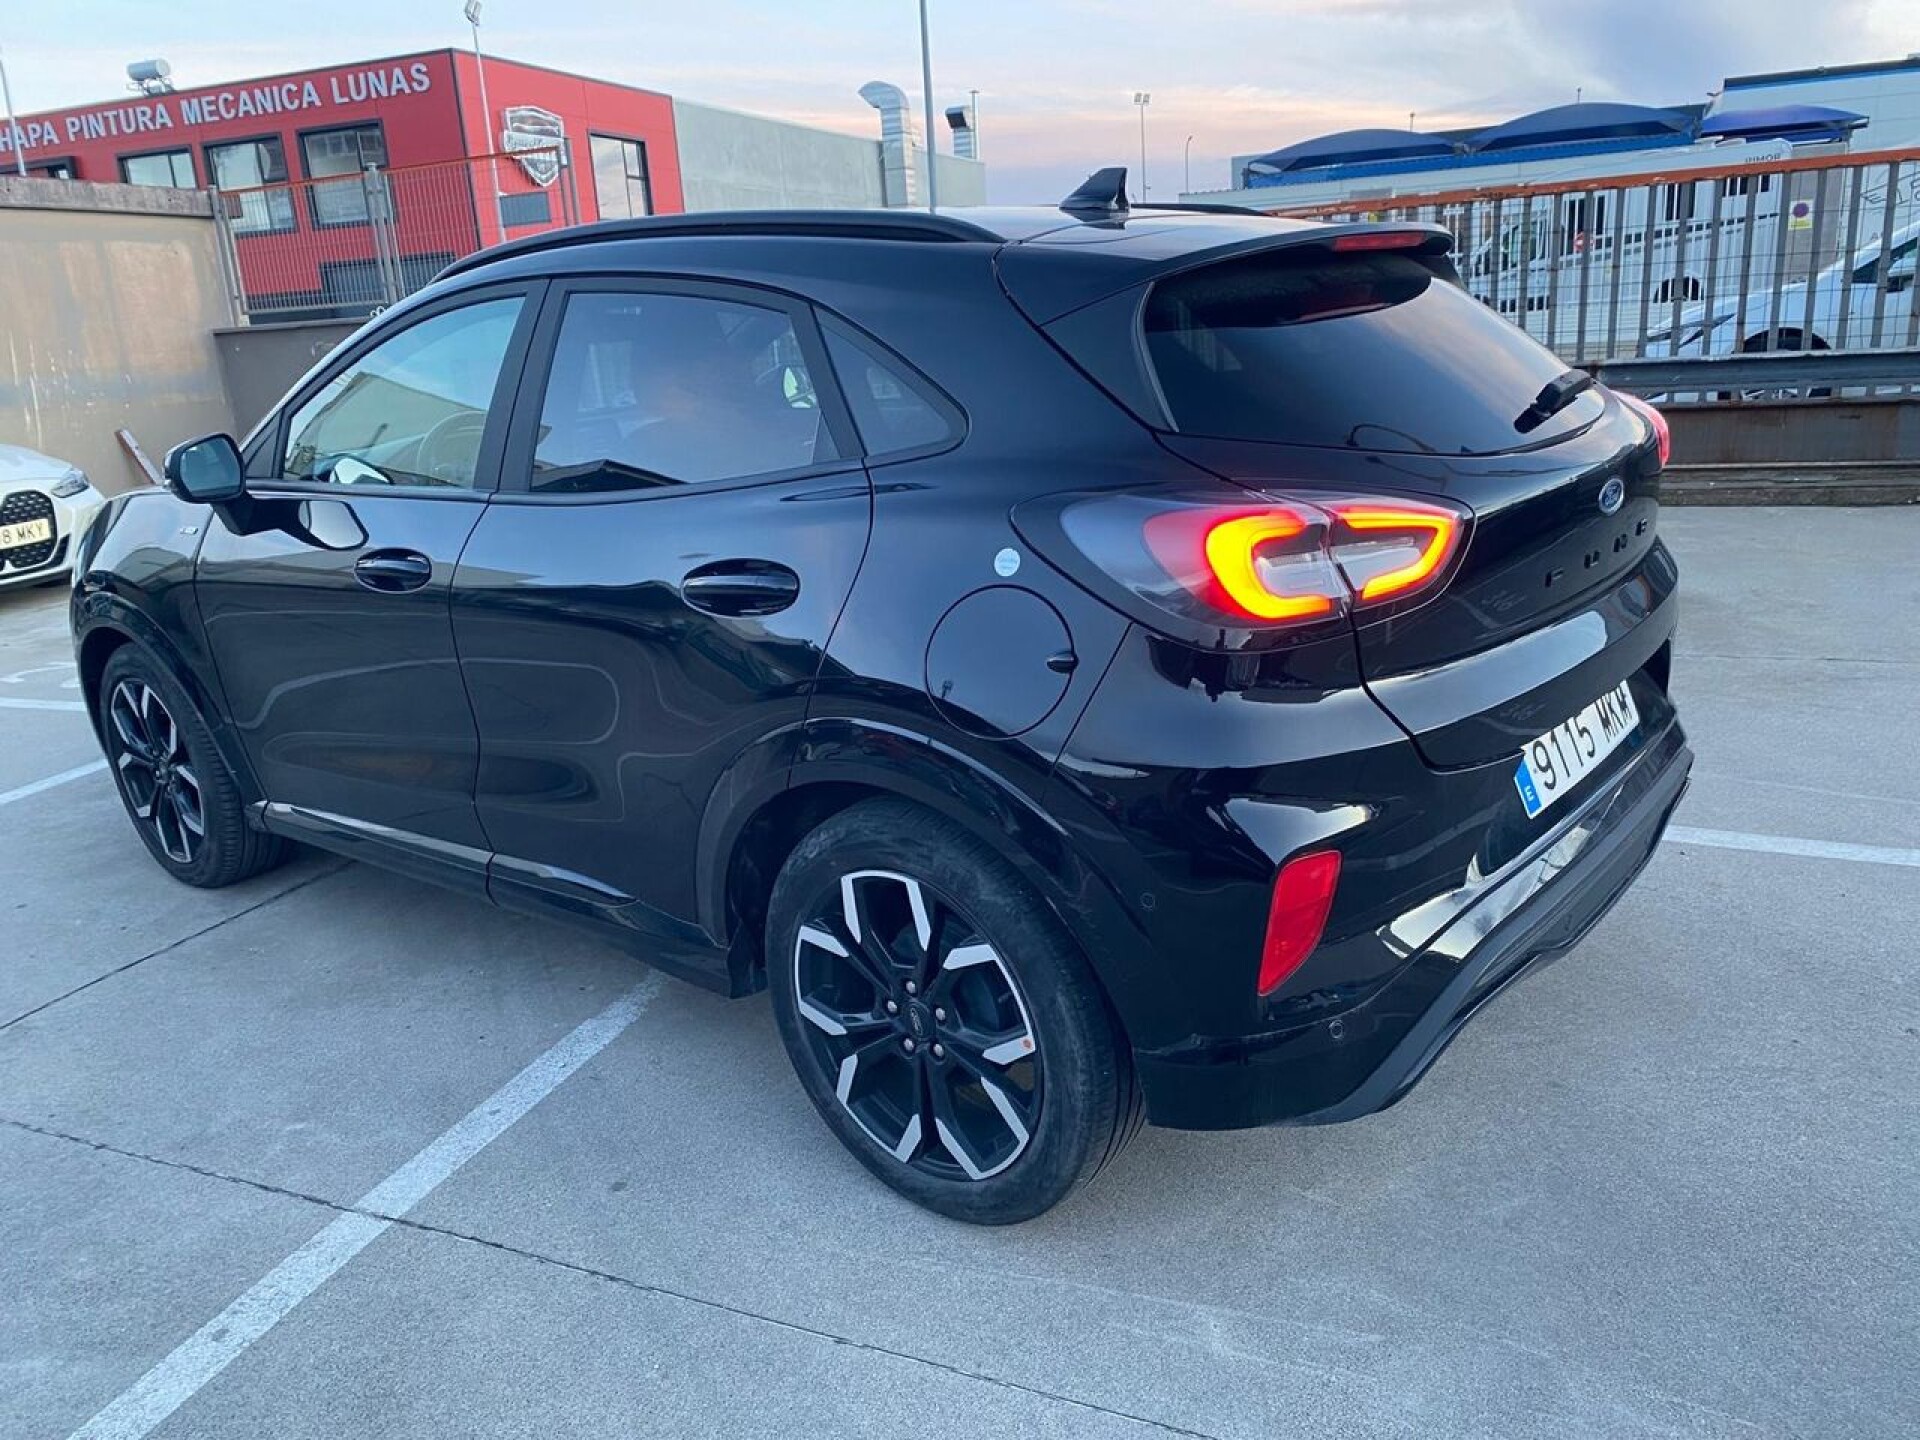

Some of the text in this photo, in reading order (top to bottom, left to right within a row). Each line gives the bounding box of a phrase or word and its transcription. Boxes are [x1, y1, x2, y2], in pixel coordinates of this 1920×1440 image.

[65, 102, 173, 142] PINTURA
[180, 79, 322, 126] MECANICA
[330, 62, 431, 105] LUNAS
[1532, 716, 1596, 790] 9115
